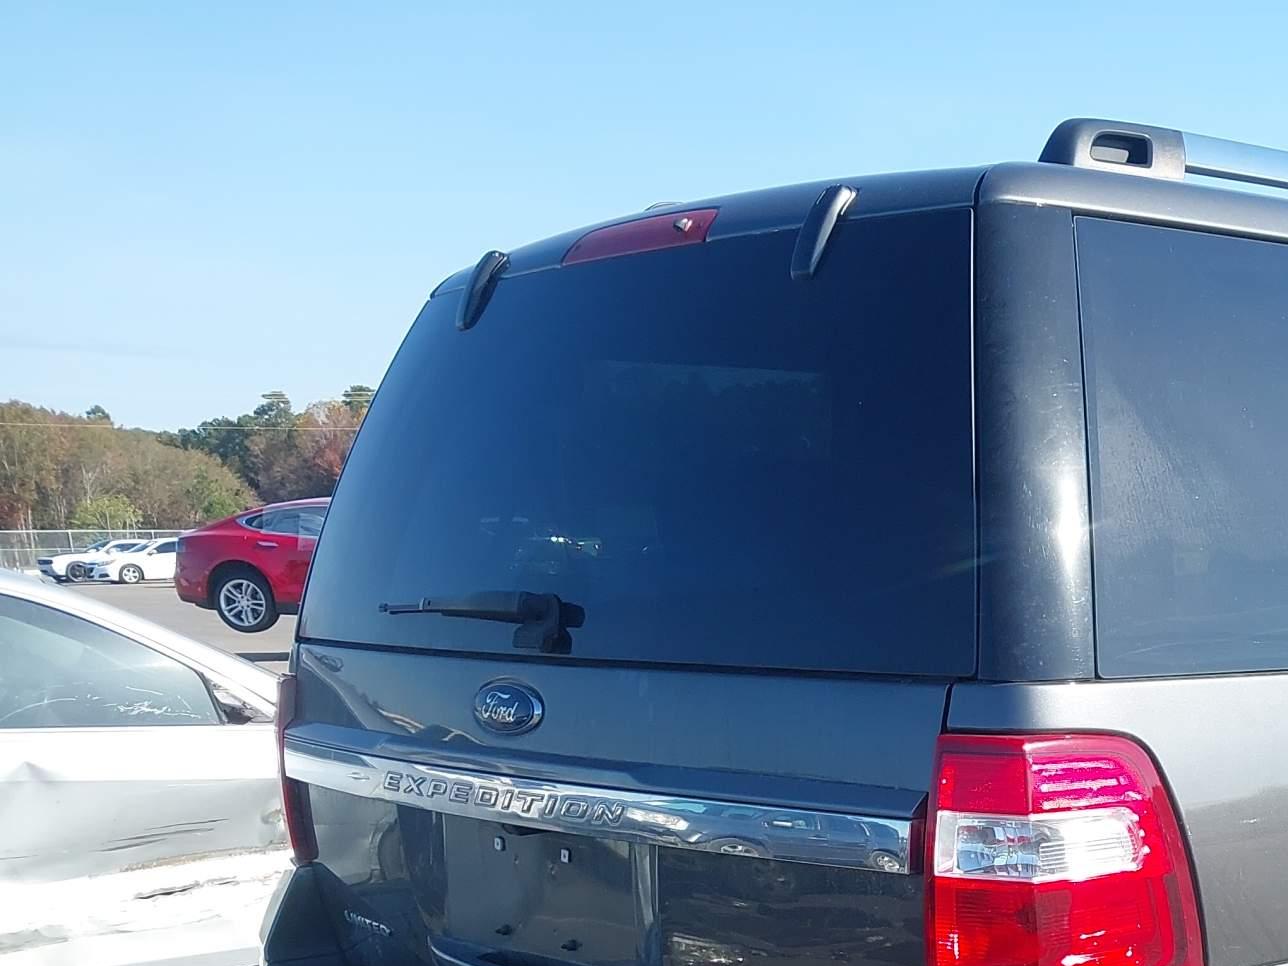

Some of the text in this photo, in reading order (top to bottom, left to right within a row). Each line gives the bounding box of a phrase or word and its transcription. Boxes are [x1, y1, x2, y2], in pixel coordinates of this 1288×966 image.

[483, 691, 519, 722] Ford
[384, 770, 625, 826] EXPEDITION
[344, 909, 391, 937] LIMITED
